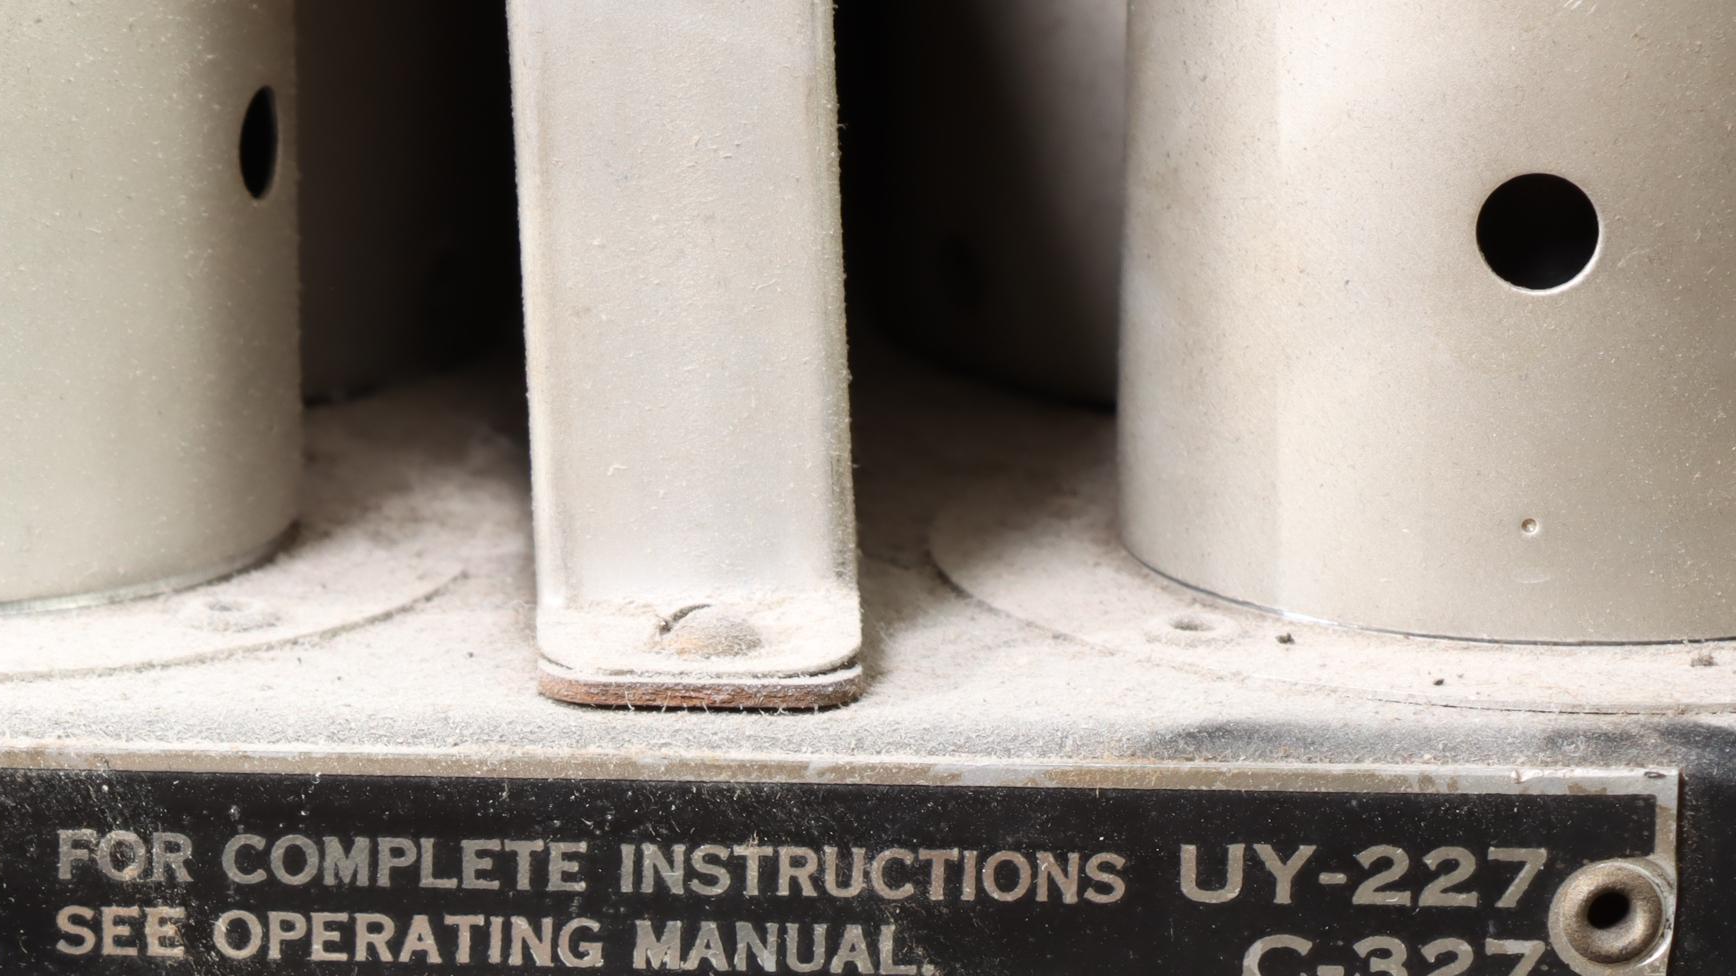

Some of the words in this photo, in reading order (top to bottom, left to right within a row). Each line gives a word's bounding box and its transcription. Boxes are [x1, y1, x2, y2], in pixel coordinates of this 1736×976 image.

[56, 829, 194, 882] FOR
[222, 833, 587, 892] COMPLETE
[621, 843, 1126, 906] INSTRUCTIONS
[1180, 843, 1548, 909] UY-227
[56, 906, 185, 957] SEE
[213, 909, 603, 969] OPERATING
[633, 920, 937, 976] MANUAL.
